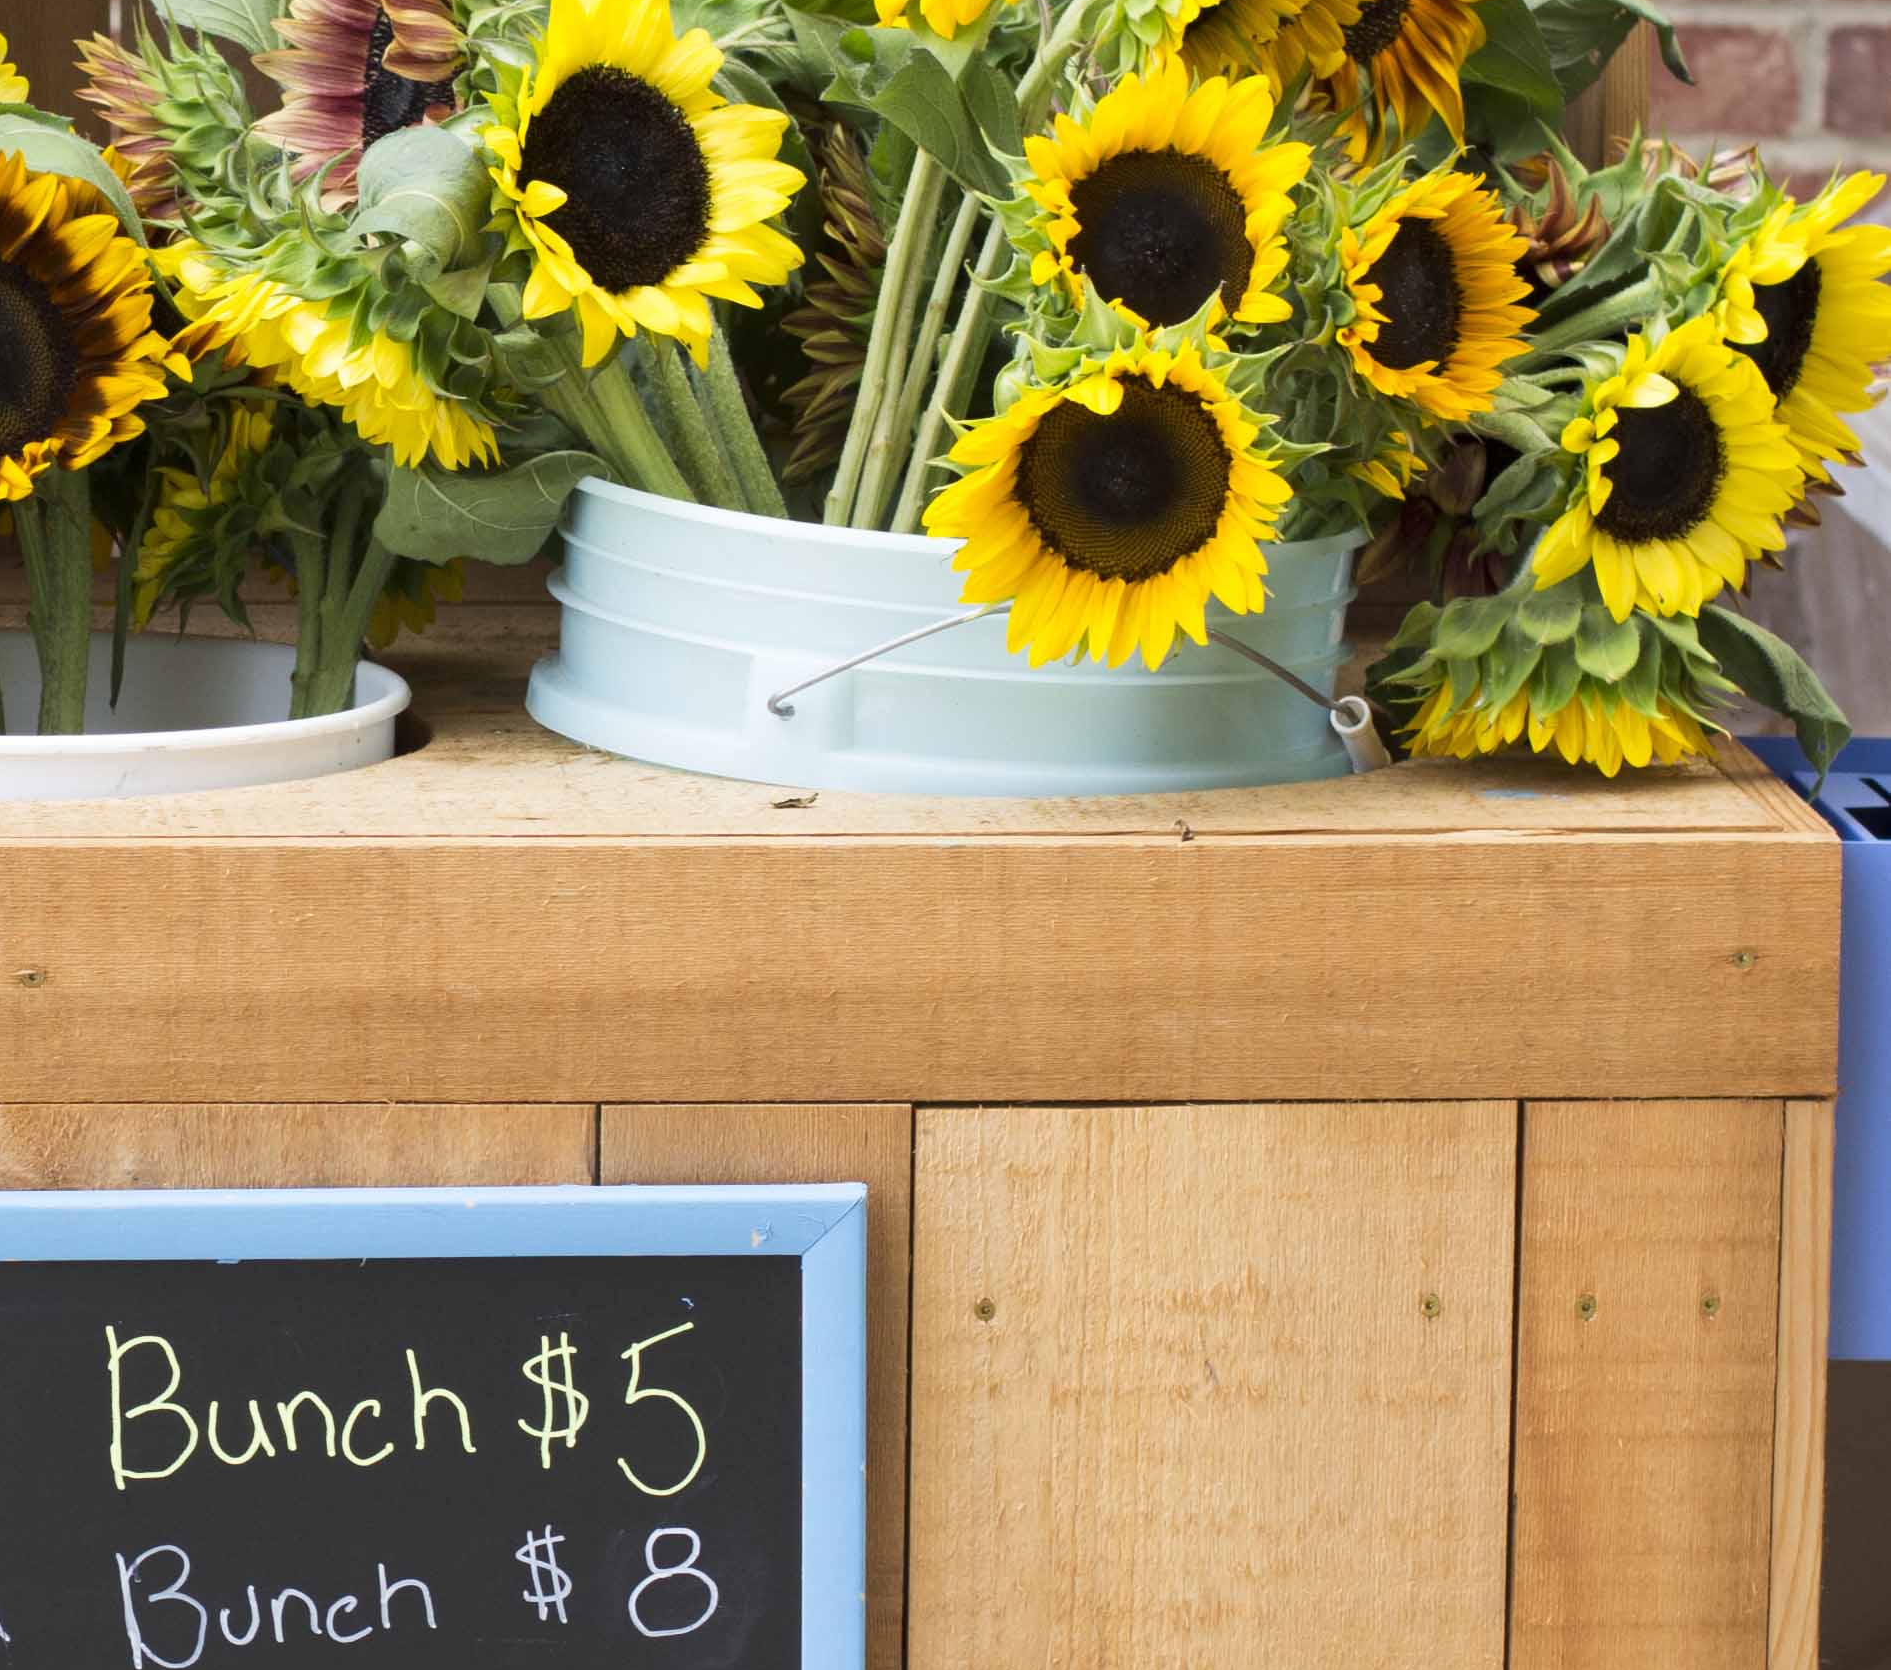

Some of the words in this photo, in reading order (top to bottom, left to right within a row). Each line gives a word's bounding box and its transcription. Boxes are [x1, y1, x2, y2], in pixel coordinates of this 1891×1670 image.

[106, 1325, 477, 1490] Bunch
[518, 1322, 706, 1496] $5
[116, 1545, 437, 1670] Bunch
